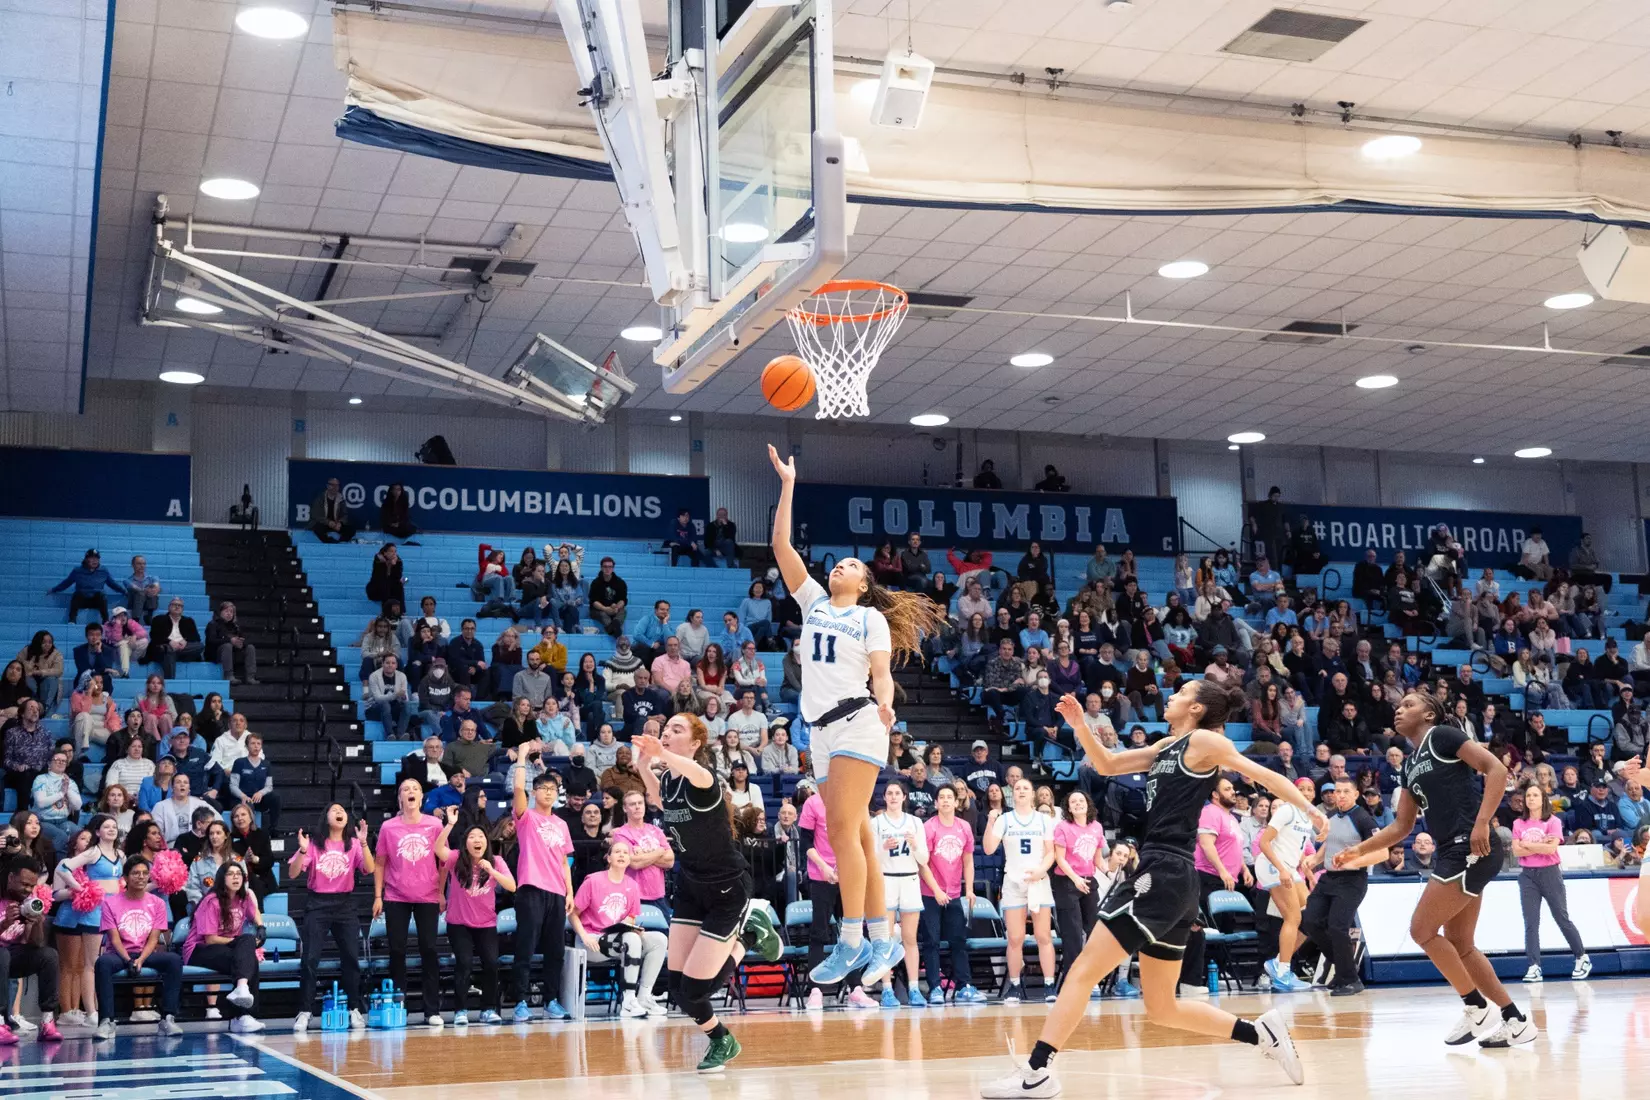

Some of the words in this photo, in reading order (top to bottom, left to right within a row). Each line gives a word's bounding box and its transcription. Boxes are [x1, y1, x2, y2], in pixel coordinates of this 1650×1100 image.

[166, 499, 183, 517] A
[295, 504, 311, 522] B
[848, 497, 1130, 543] COLUMBIA
[1162, 536, 1173, 551] C
[806, 616, 862, 641] COLUMBIA
[812, 632, 837, 663] 11
[669, 826, 687, 853] 1
[888, 839, 910, 858] 24
[1019, 838, 1032, 855] 5
[1300, 835, 1306, 850] 1
